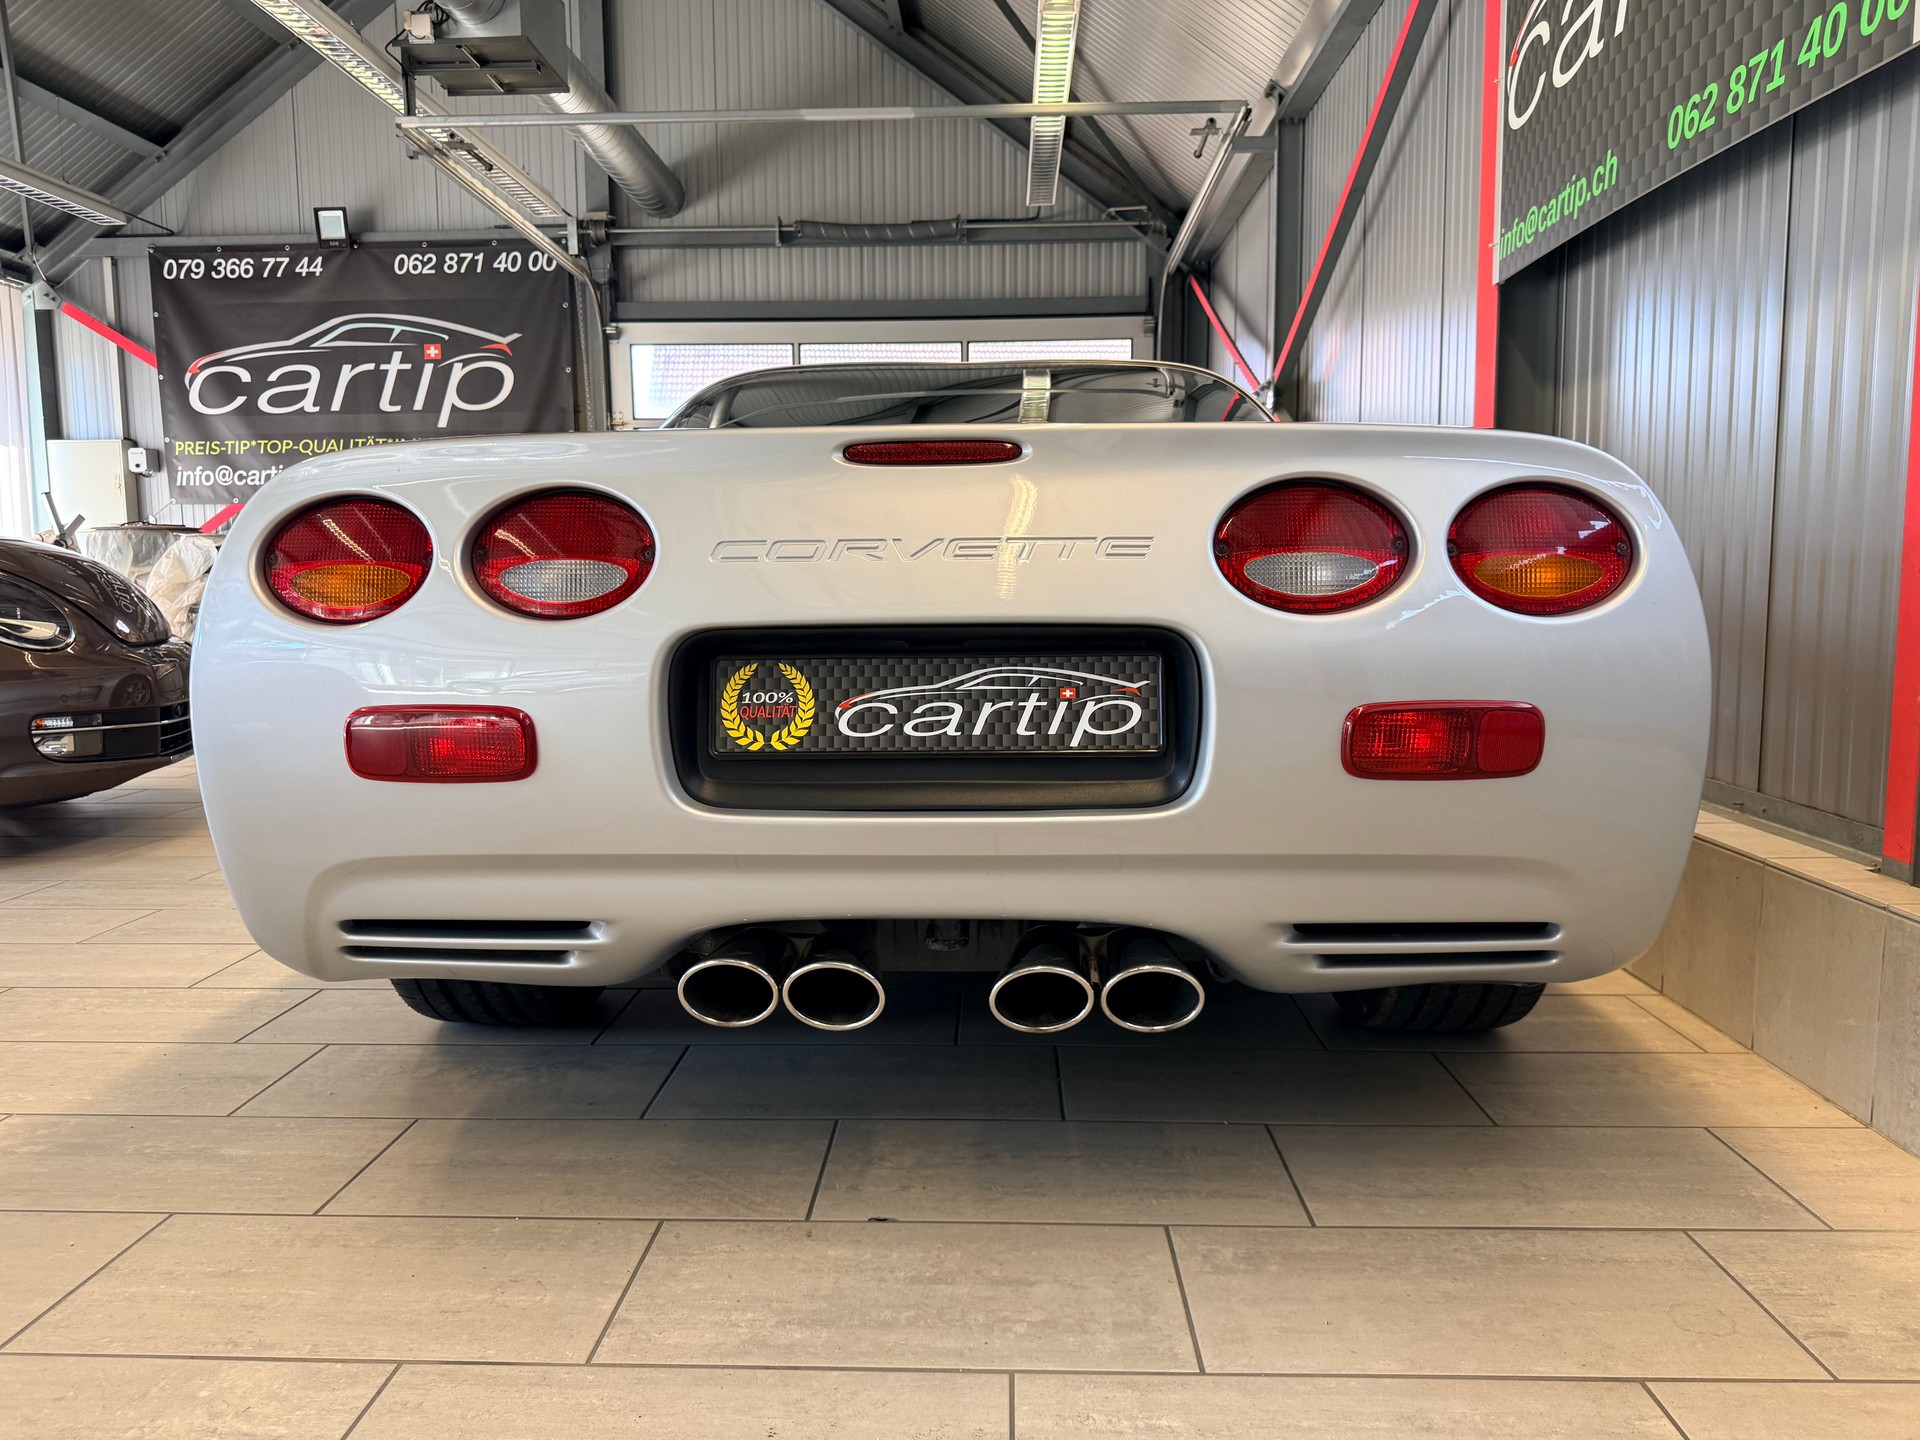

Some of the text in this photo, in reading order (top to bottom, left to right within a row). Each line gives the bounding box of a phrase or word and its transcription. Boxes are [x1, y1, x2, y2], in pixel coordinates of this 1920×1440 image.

[1667, 82, 1718, 150] 062
[1726, 38, 1786, 114] 871
[1797, 2, 1848, 69] 40
[1499, 148, 1618, 261] info@cartip.ch
[163, 255, 323, 279] 079 366 77 44
[393, 250, 558, 275] 062 871 40 00
[189, 343, 515, 429] cartip
[707, 536, 1157, 563] CORVETTE
[741, 691, 794, 704] 100%
[739, 703, 798, 720] QUALITÄT
[837, 687, 1143, 747] cartip
